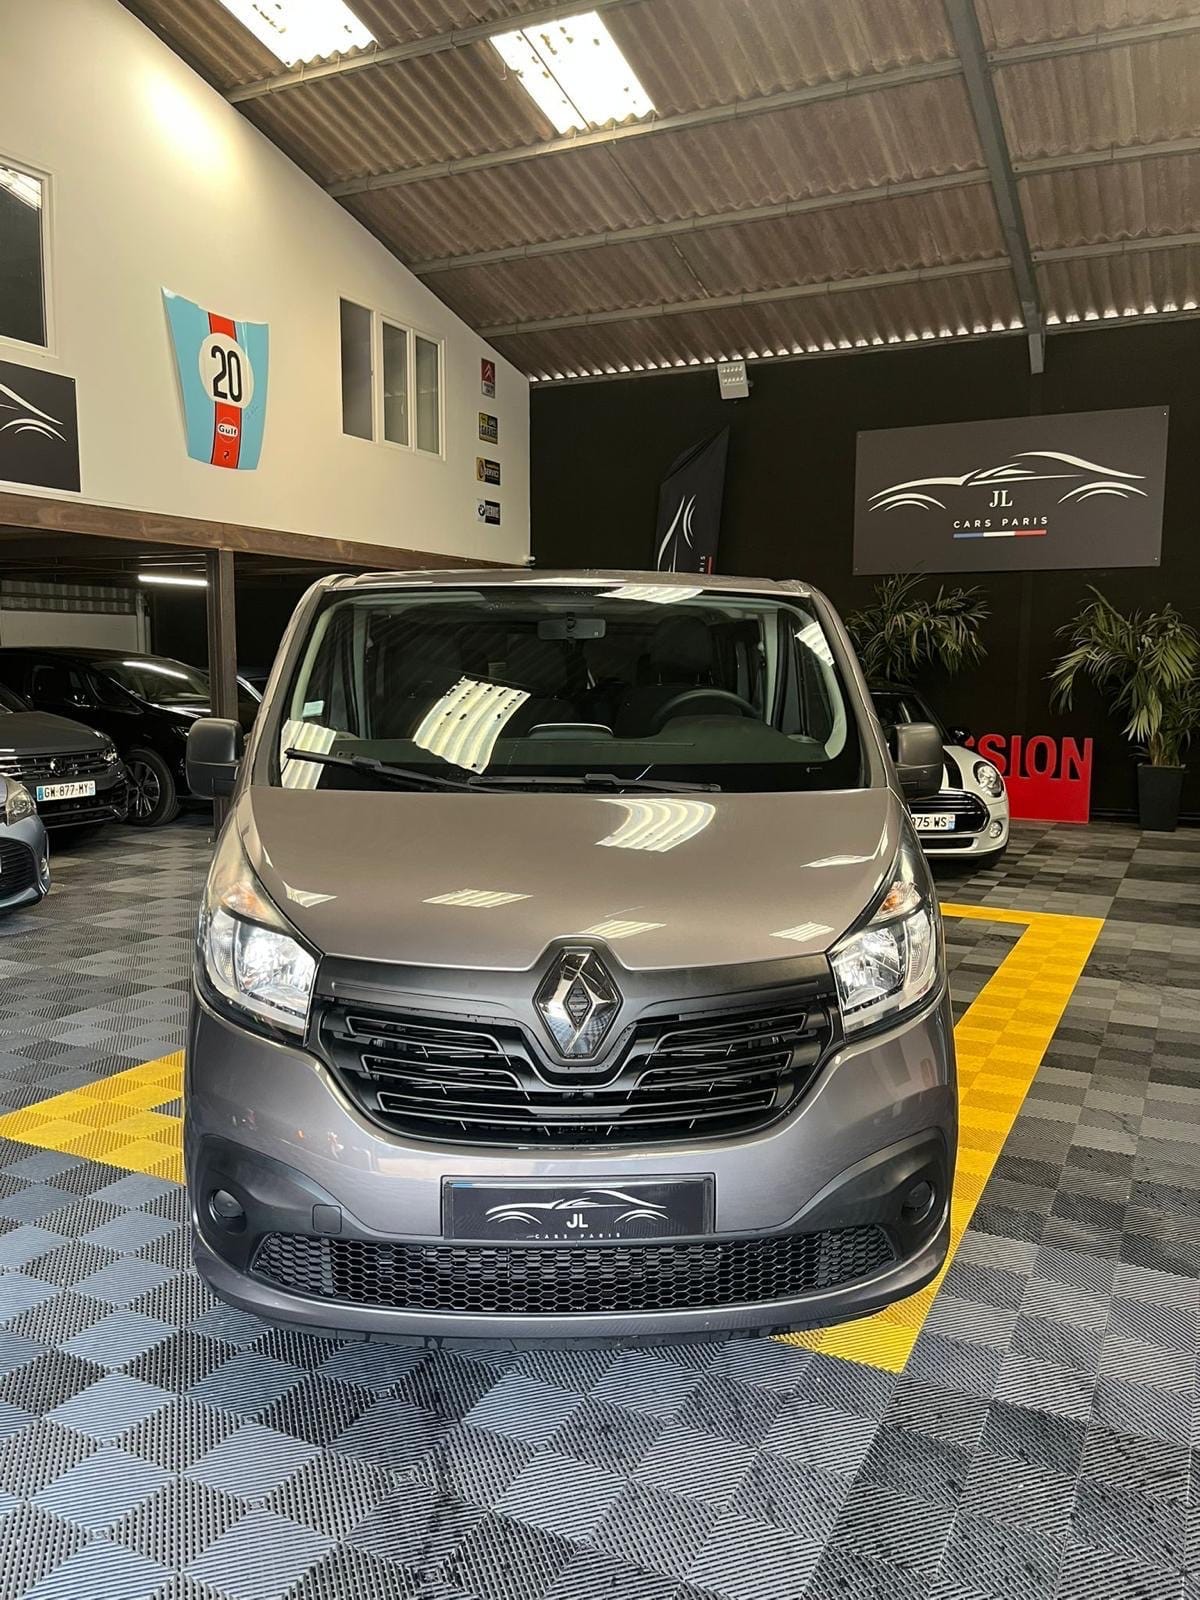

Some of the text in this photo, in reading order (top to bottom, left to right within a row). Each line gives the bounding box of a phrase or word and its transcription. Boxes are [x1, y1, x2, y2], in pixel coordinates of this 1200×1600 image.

[211, 345, 242, 402] 20
[218, 424, 237, 436] Gulf
[989, 489, 1013, 508] JL
[953, 516, 1048, 529] CARS PARIS
[965, 733, 1094, 782] SION
[566, 1213, 589, 1229] JL
